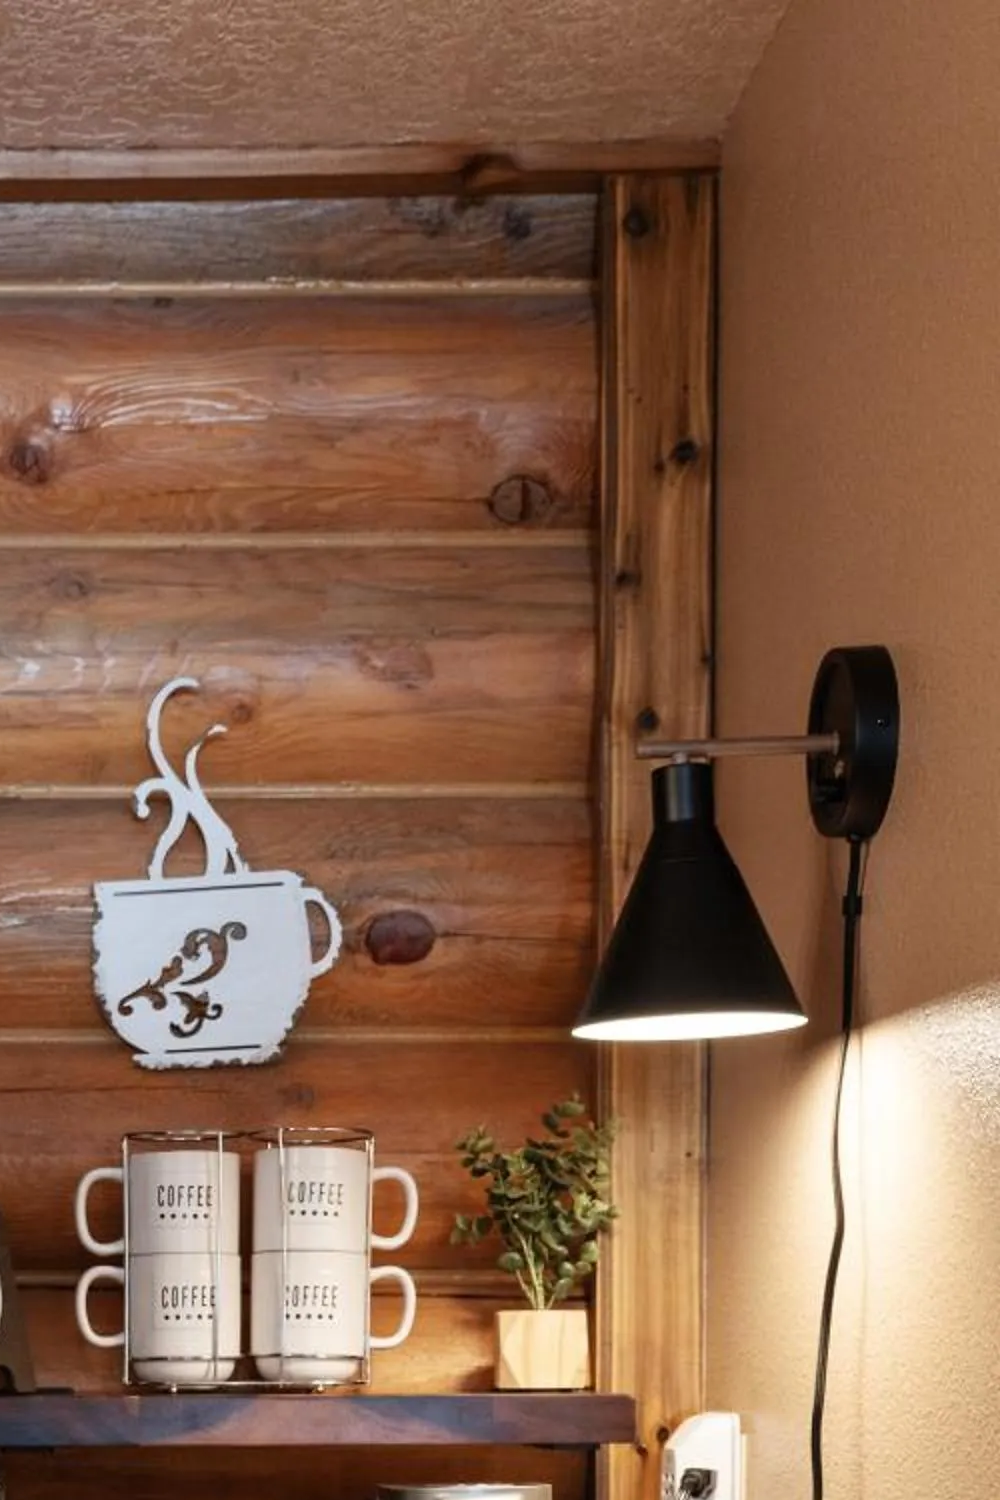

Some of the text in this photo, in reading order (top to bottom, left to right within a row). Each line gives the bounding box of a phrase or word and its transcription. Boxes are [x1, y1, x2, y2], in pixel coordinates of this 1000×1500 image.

[157, 1184, 213, 1208] COFFEE
[287, 1181, 344, 1205] COFFEE
[161, 1285, 216, 1309] COFFEE
